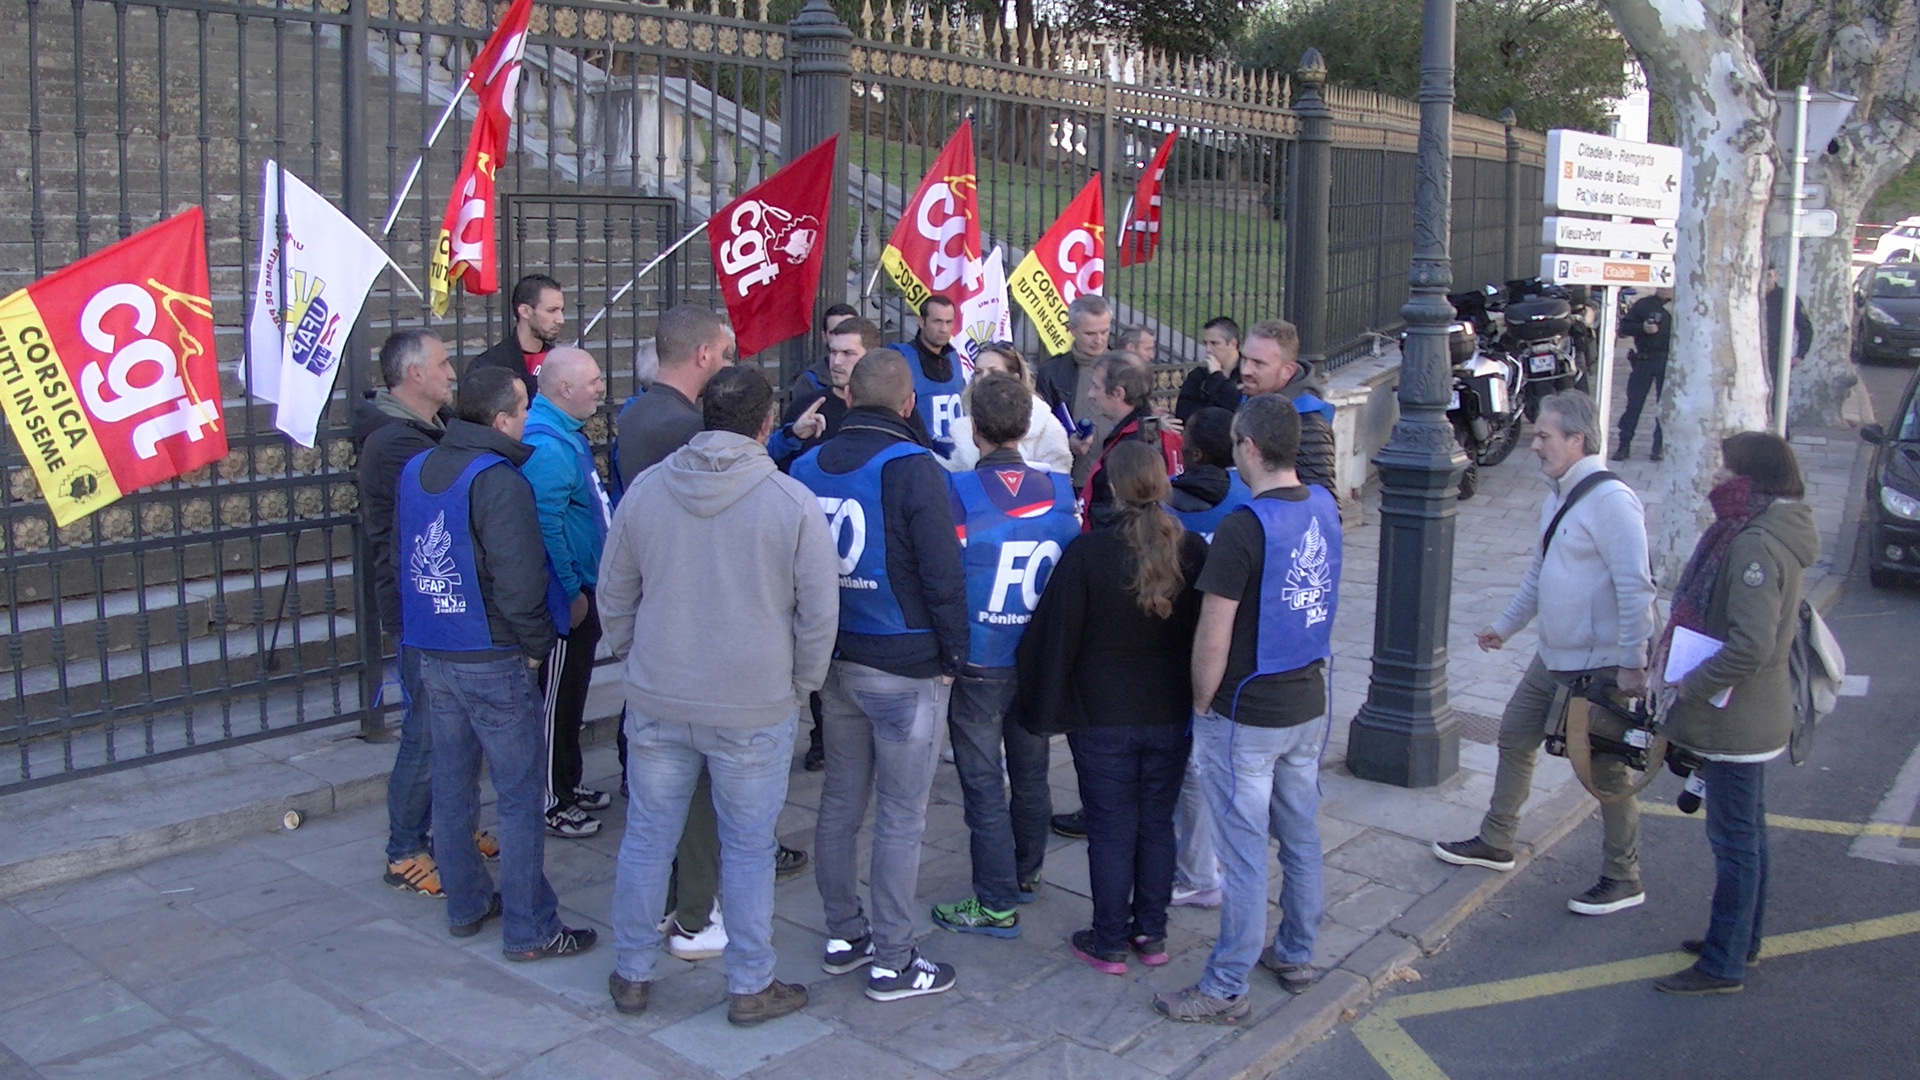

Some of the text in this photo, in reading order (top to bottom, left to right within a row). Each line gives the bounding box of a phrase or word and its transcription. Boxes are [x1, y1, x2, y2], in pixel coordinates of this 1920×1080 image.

[1578, 142, 1613, 160] Citadelle
[1619, 149, 1655, 167] Remparts
[1577, 165, 1639, 186] Musée de Bastia
[1600, 190, 1613, 204] des
[1618, 192, 1661, 209] Gouverneurs
[1561, 225, 1602, 242] Vieux-Port
[720, 200, 779, 297] cgt
[1018, 276, 1041, 309] TUTTI
[80, 283, 220, 460] cgt
[19, 326, 88, 449] CORSICA
[419, 578, 446, 593] UFAP
[988, 540, 1062, 612] FO
[979, 611, 1032, 625] Péniten
[912, 971, 935, 990] N
